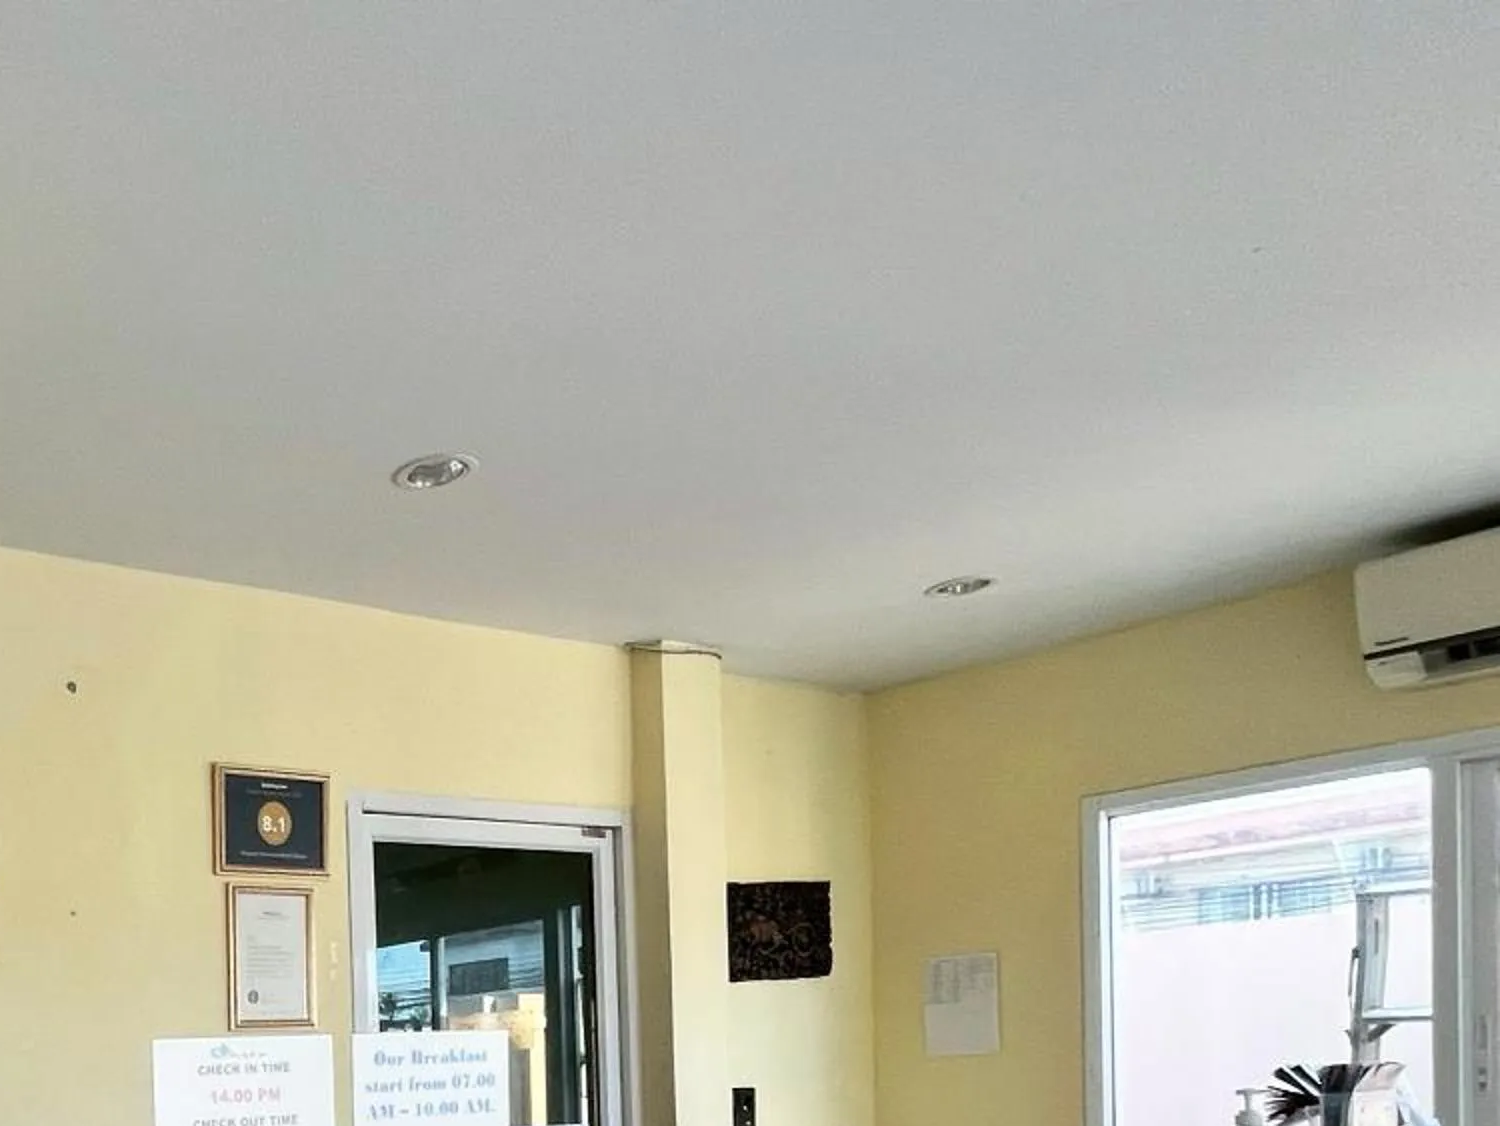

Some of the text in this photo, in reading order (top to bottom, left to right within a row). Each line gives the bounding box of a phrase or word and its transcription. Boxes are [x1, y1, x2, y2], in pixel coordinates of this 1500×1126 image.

[262, 814, 286, 833] 8.1
[373, 1048, 488, 1066] Our Breakfast
[197, 1061, 291, 1076] CHECK IN TIME
[364, 1071, 496, 1093] start from 07.00
[211, 1086, 281, 1105] 14.00 PM
[269, 1114, 299, 1126] TIME
[367, 1103, 396, 1121] AM
[415, 1101, 459, 1117] 10.00
